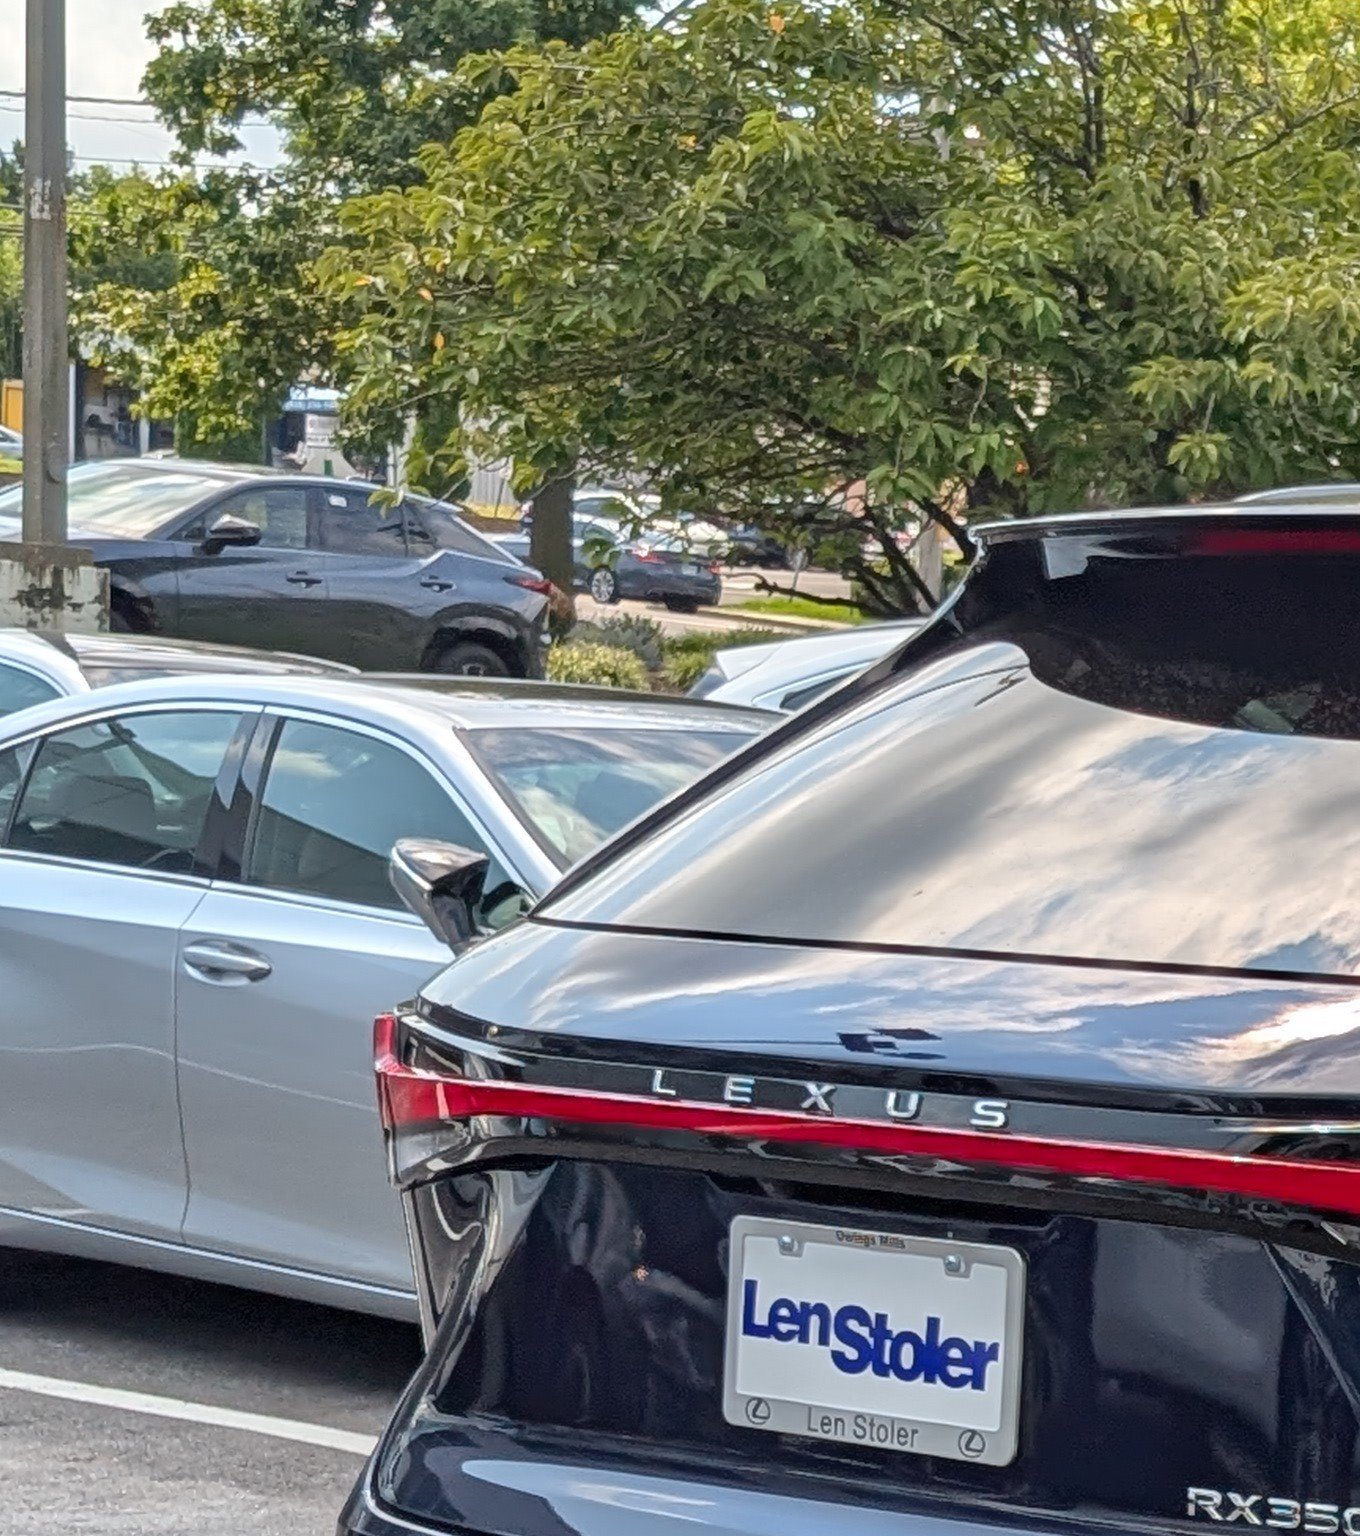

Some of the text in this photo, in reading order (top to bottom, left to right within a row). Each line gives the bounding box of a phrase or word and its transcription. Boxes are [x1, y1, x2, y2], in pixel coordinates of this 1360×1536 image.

[652, 1068, 1008, 1128] LEXUS
[807, 1406, 919, 1448] Len Stoler
